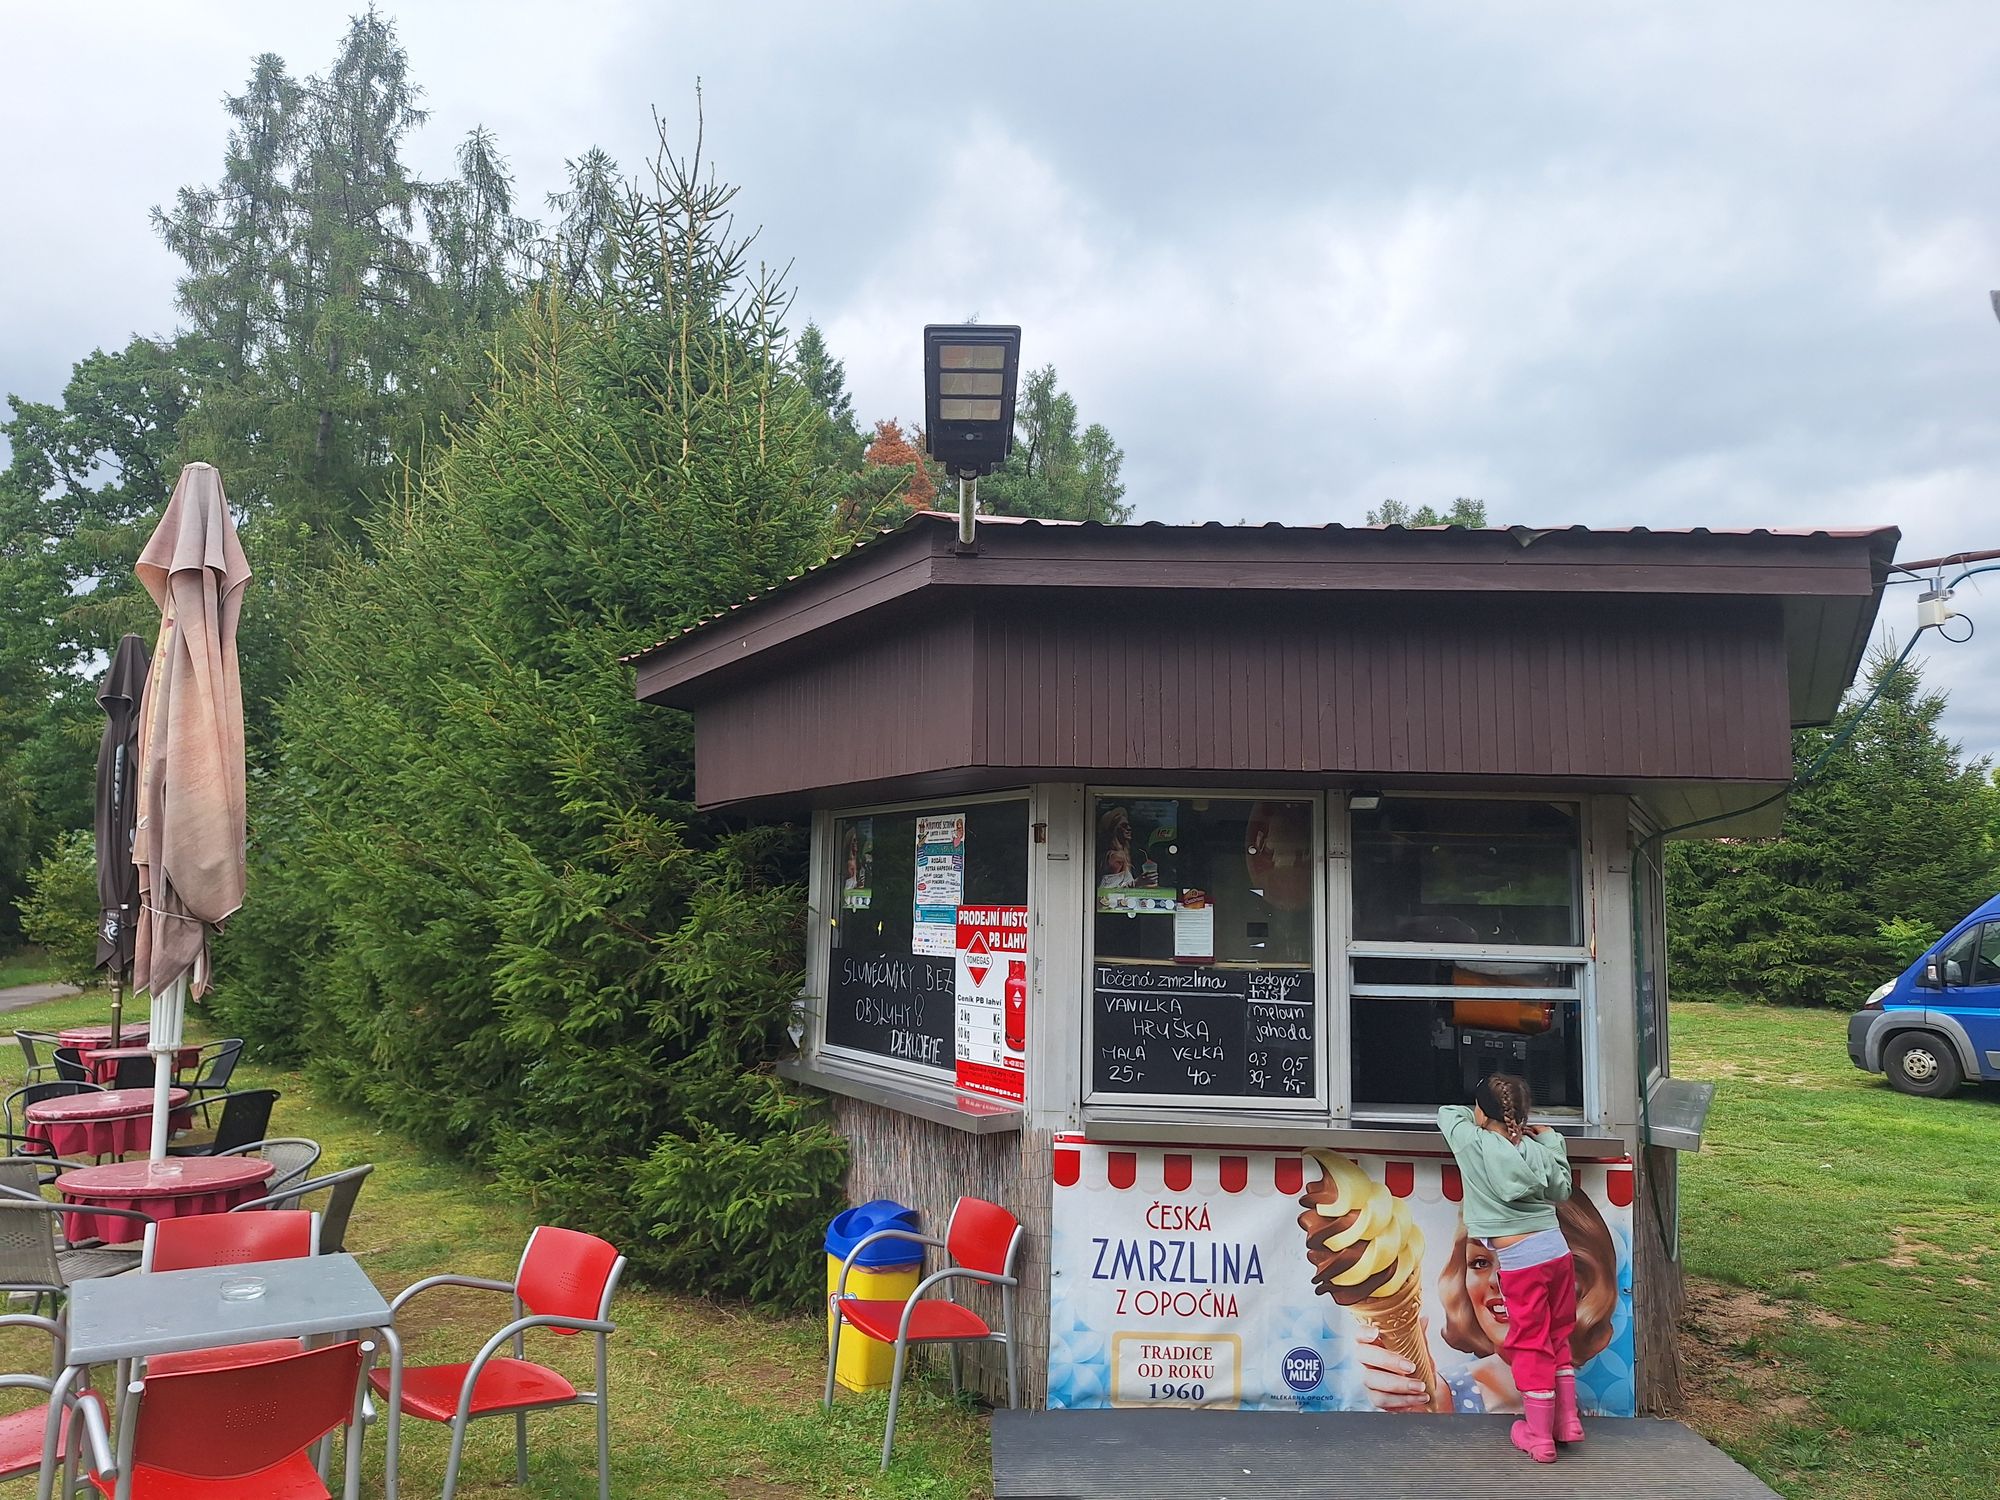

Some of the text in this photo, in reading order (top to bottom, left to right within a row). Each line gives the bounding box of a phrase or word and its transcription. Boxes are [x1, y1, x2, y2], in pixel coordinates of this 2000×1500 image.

[959, 908, 1000, 926] PRODEJNÍ
[989, 932, 1000, 947] PB
[967, 955, 990, 965] TOMEGAS
[926, 964, 954, 995] BEZ
[1098, 967, 1227, 989] Točená zmrzlina
[957, 994, 1002, 1006] Ceník PB lahví
[1105, 998, 1183, 1014] VANILKA
[960, 1009, 1000, 1026] 2 kg Kč
[1253, 1005, 1304, 1020] meloun
[964, 1027, 970, 1042] kg
[993, 1031, 1000, 1044] Kč
[1133, 1017, 1209, 1042] HRUŠKA
[1256, 1019, 1312, 1042] jahoda
[889, 1028, 944, 1064] DĚKUJEME
[964, 1045, 970, 1060] kg
[993, 1049, 1000, 1062] Kč
[1102, 1038, 1224, 1061] MALÁ VELKÁ
[1249, 1052, 1308, 1076] 0,3 0,5
[965, 1081, 1021, 1098] www.tomegas.cz
[1146, 1200, 1211, 1231] ČESKÁ
[1092, 1238, 1264, 1284] ZMRZLINA
[1116, 1288, 1239, 1318] Z OPOČNA
[1141, 1345, 1213, 1360] TRADICE
[1138, 1363, 1215, 1379] OD ROKU
[1286, 1359, 1320, 1370] BOHE
[1289, 1370, 1318, 1381] MILK
[1149, 1382, 1205, 1401] 1960
